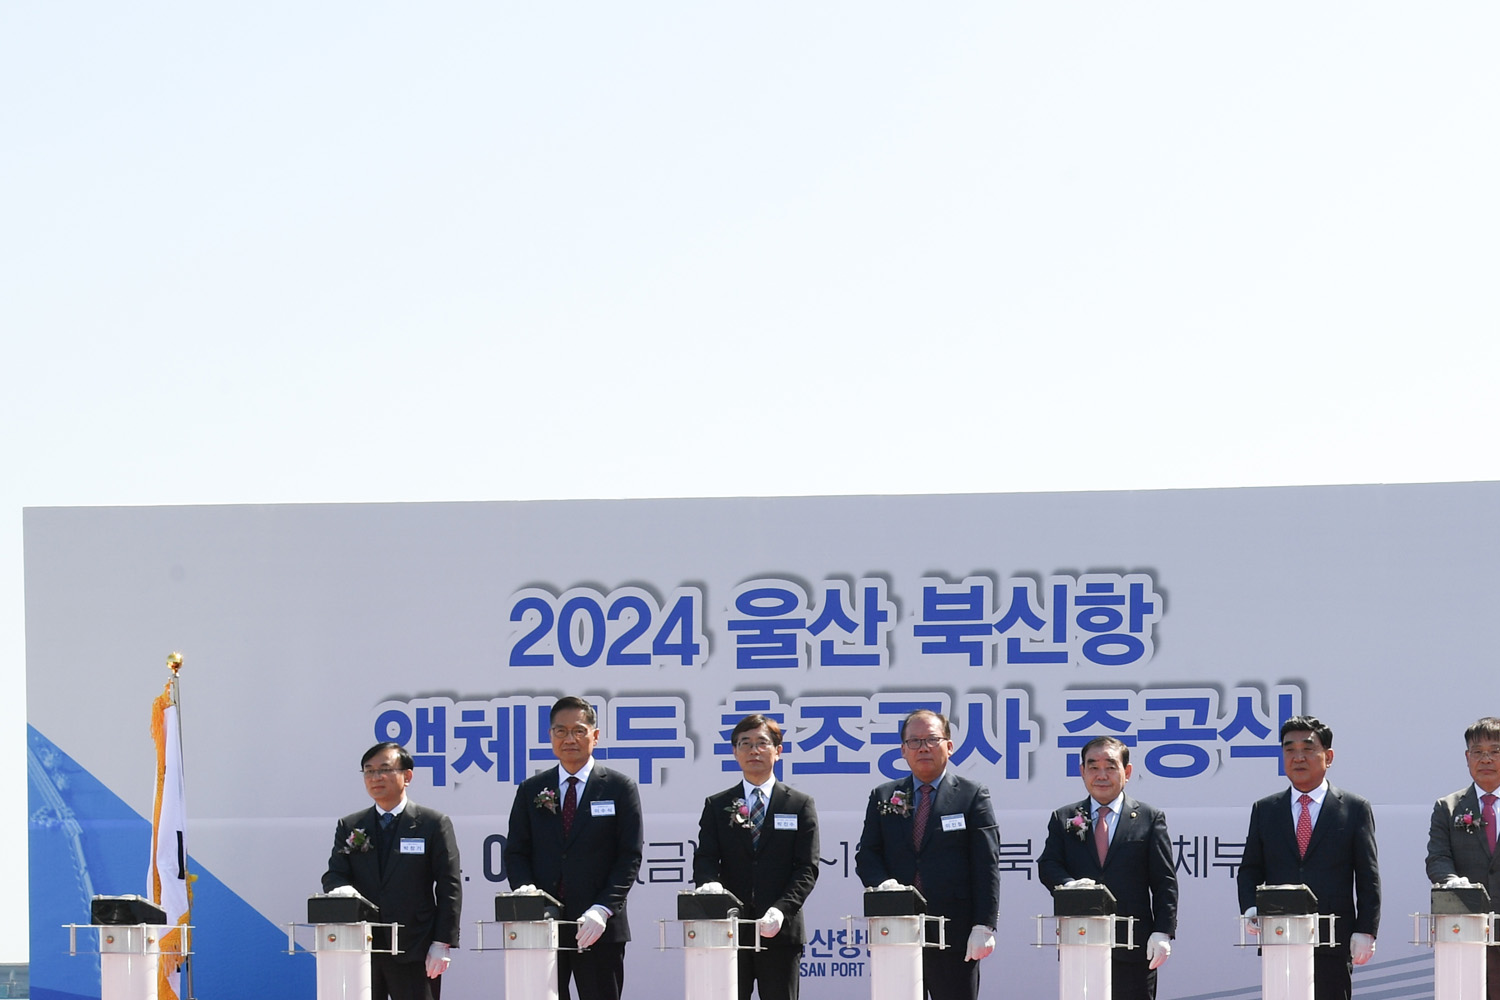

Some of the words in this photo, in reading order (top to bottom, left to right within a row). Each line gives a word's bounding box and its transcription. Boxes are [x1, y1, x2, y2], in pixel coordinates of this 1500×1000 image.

[509, 596, 700, 668] 2024
[727, 587, 888, 669] 울산
[913, 582, 1154, 667] 북신항
[1057, 694, 1293, 778] 준공식
[831, 962, 865, 977] PORT
